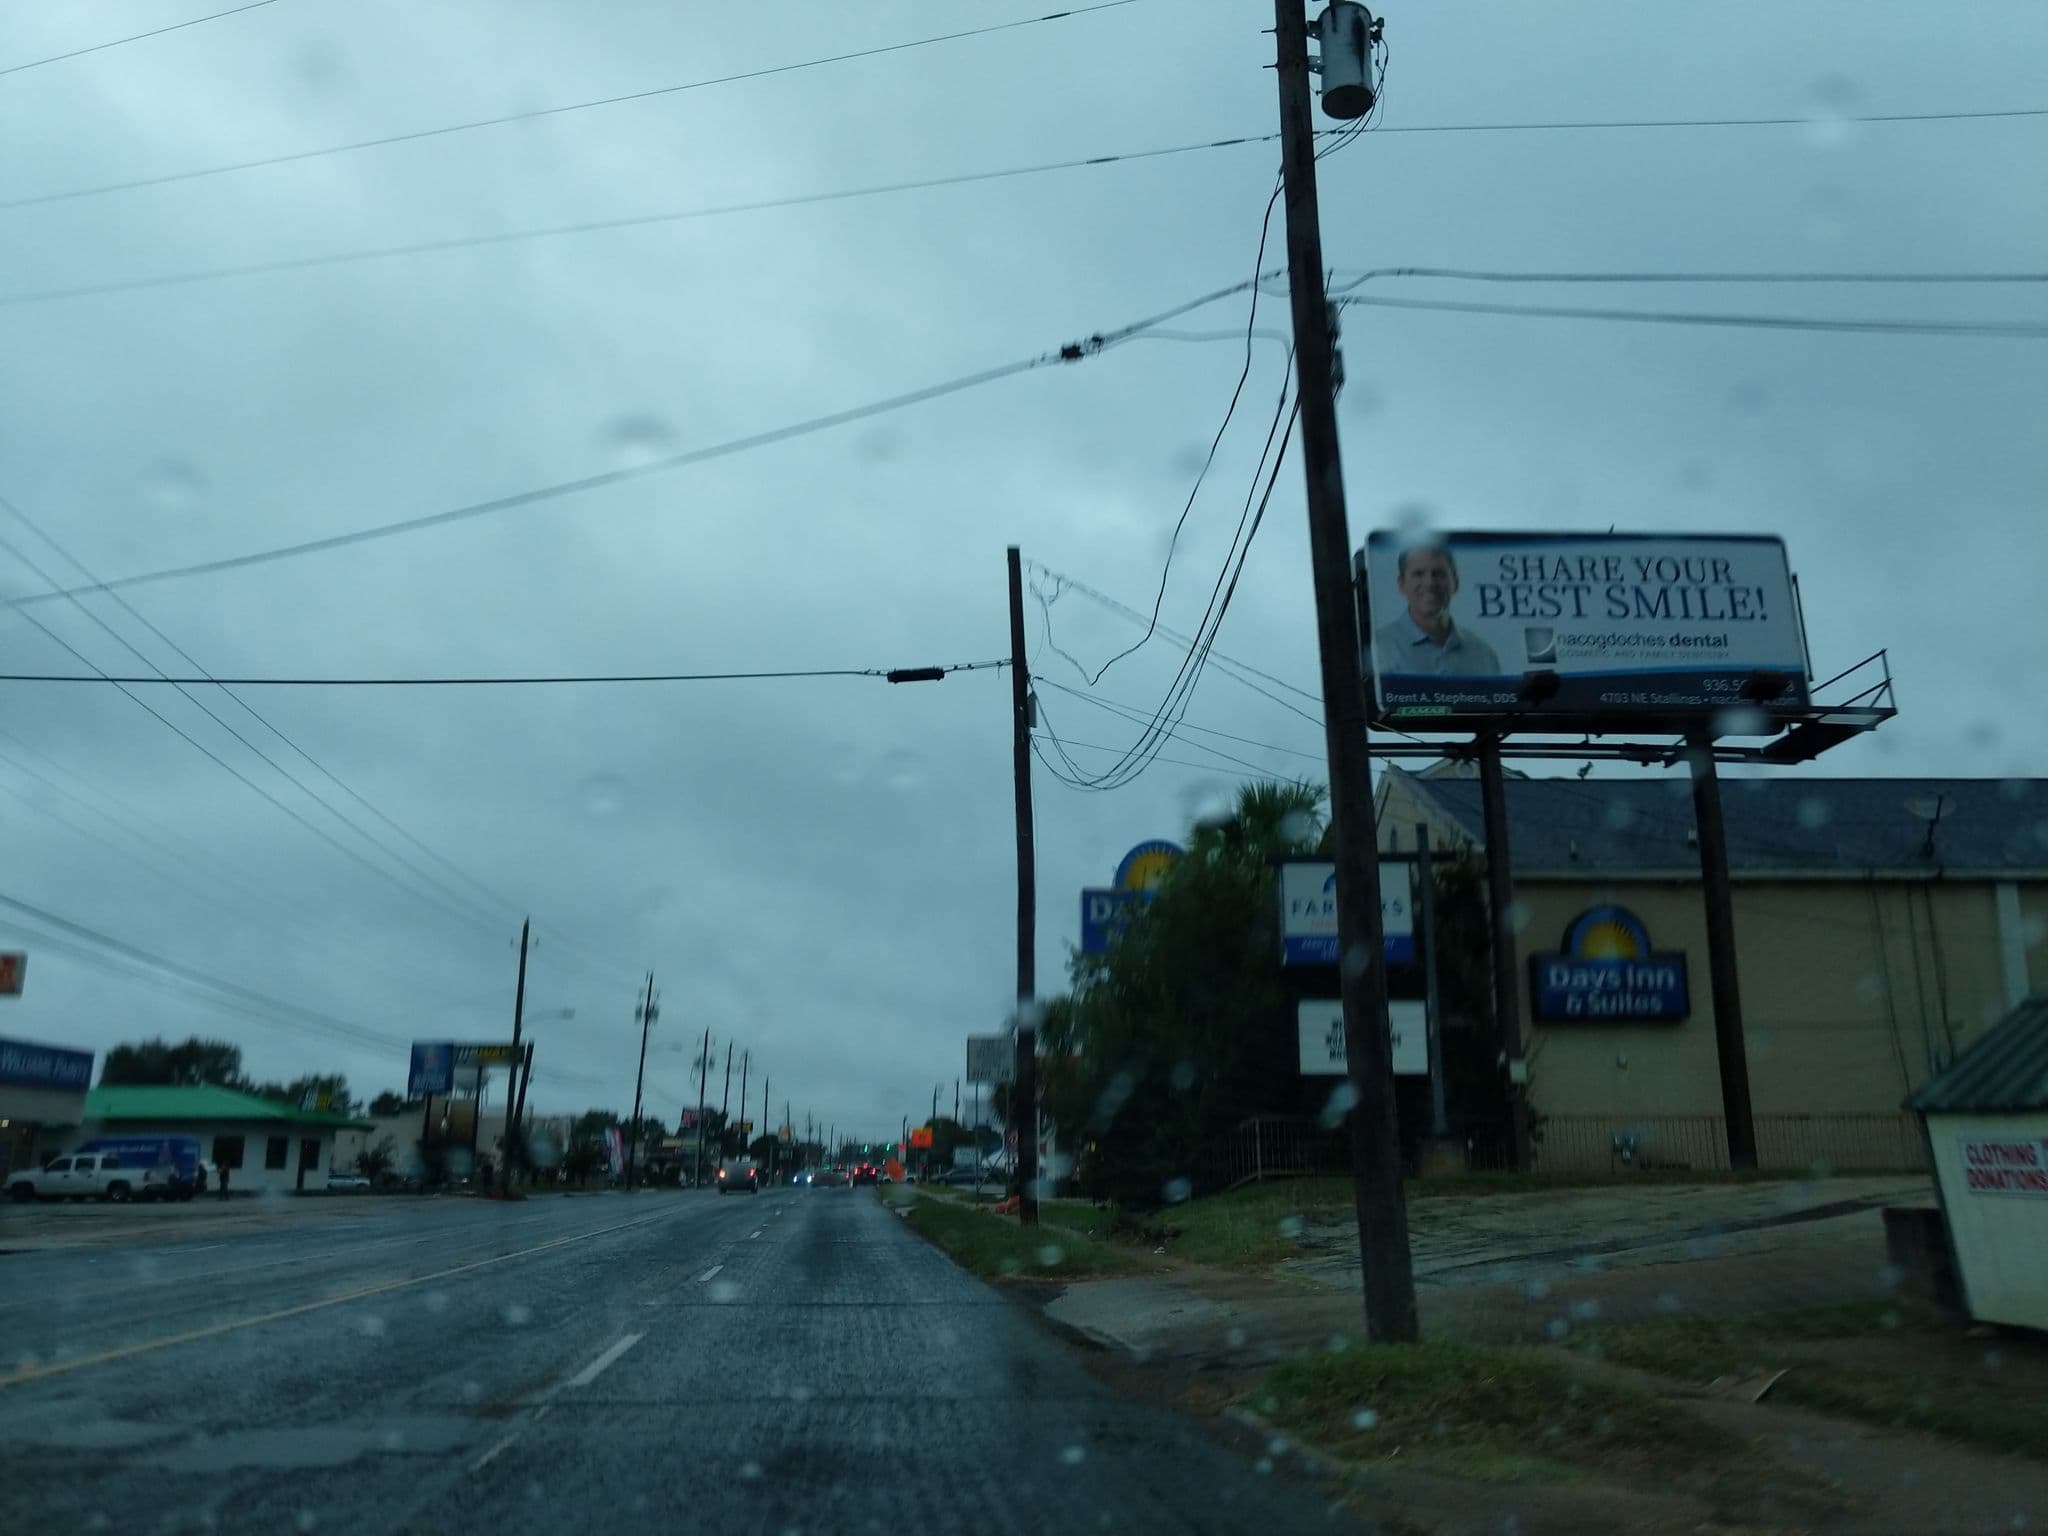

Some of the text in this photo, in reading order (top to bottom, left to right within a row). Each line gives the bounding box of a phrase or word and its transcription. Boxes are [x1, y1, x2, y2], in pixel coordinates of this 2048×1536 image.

[1499, 554, 1736, 585] SHARE YOUR
[1476, 584, 1768, 621] BEST SMILE!
[1557, 631, 1728, 649] nacogdoches dental
[1386, 693, 1416, 703] Brent
[1433, 693, 1491, 704] Stephens,
[1493, 693, 1518, 703] DDS
[1631, 693, 1648, 704] NE
[1549, 964, 1675, 990] Days Inn
[1967, 1144, 2037, 1166] CLOTHING
